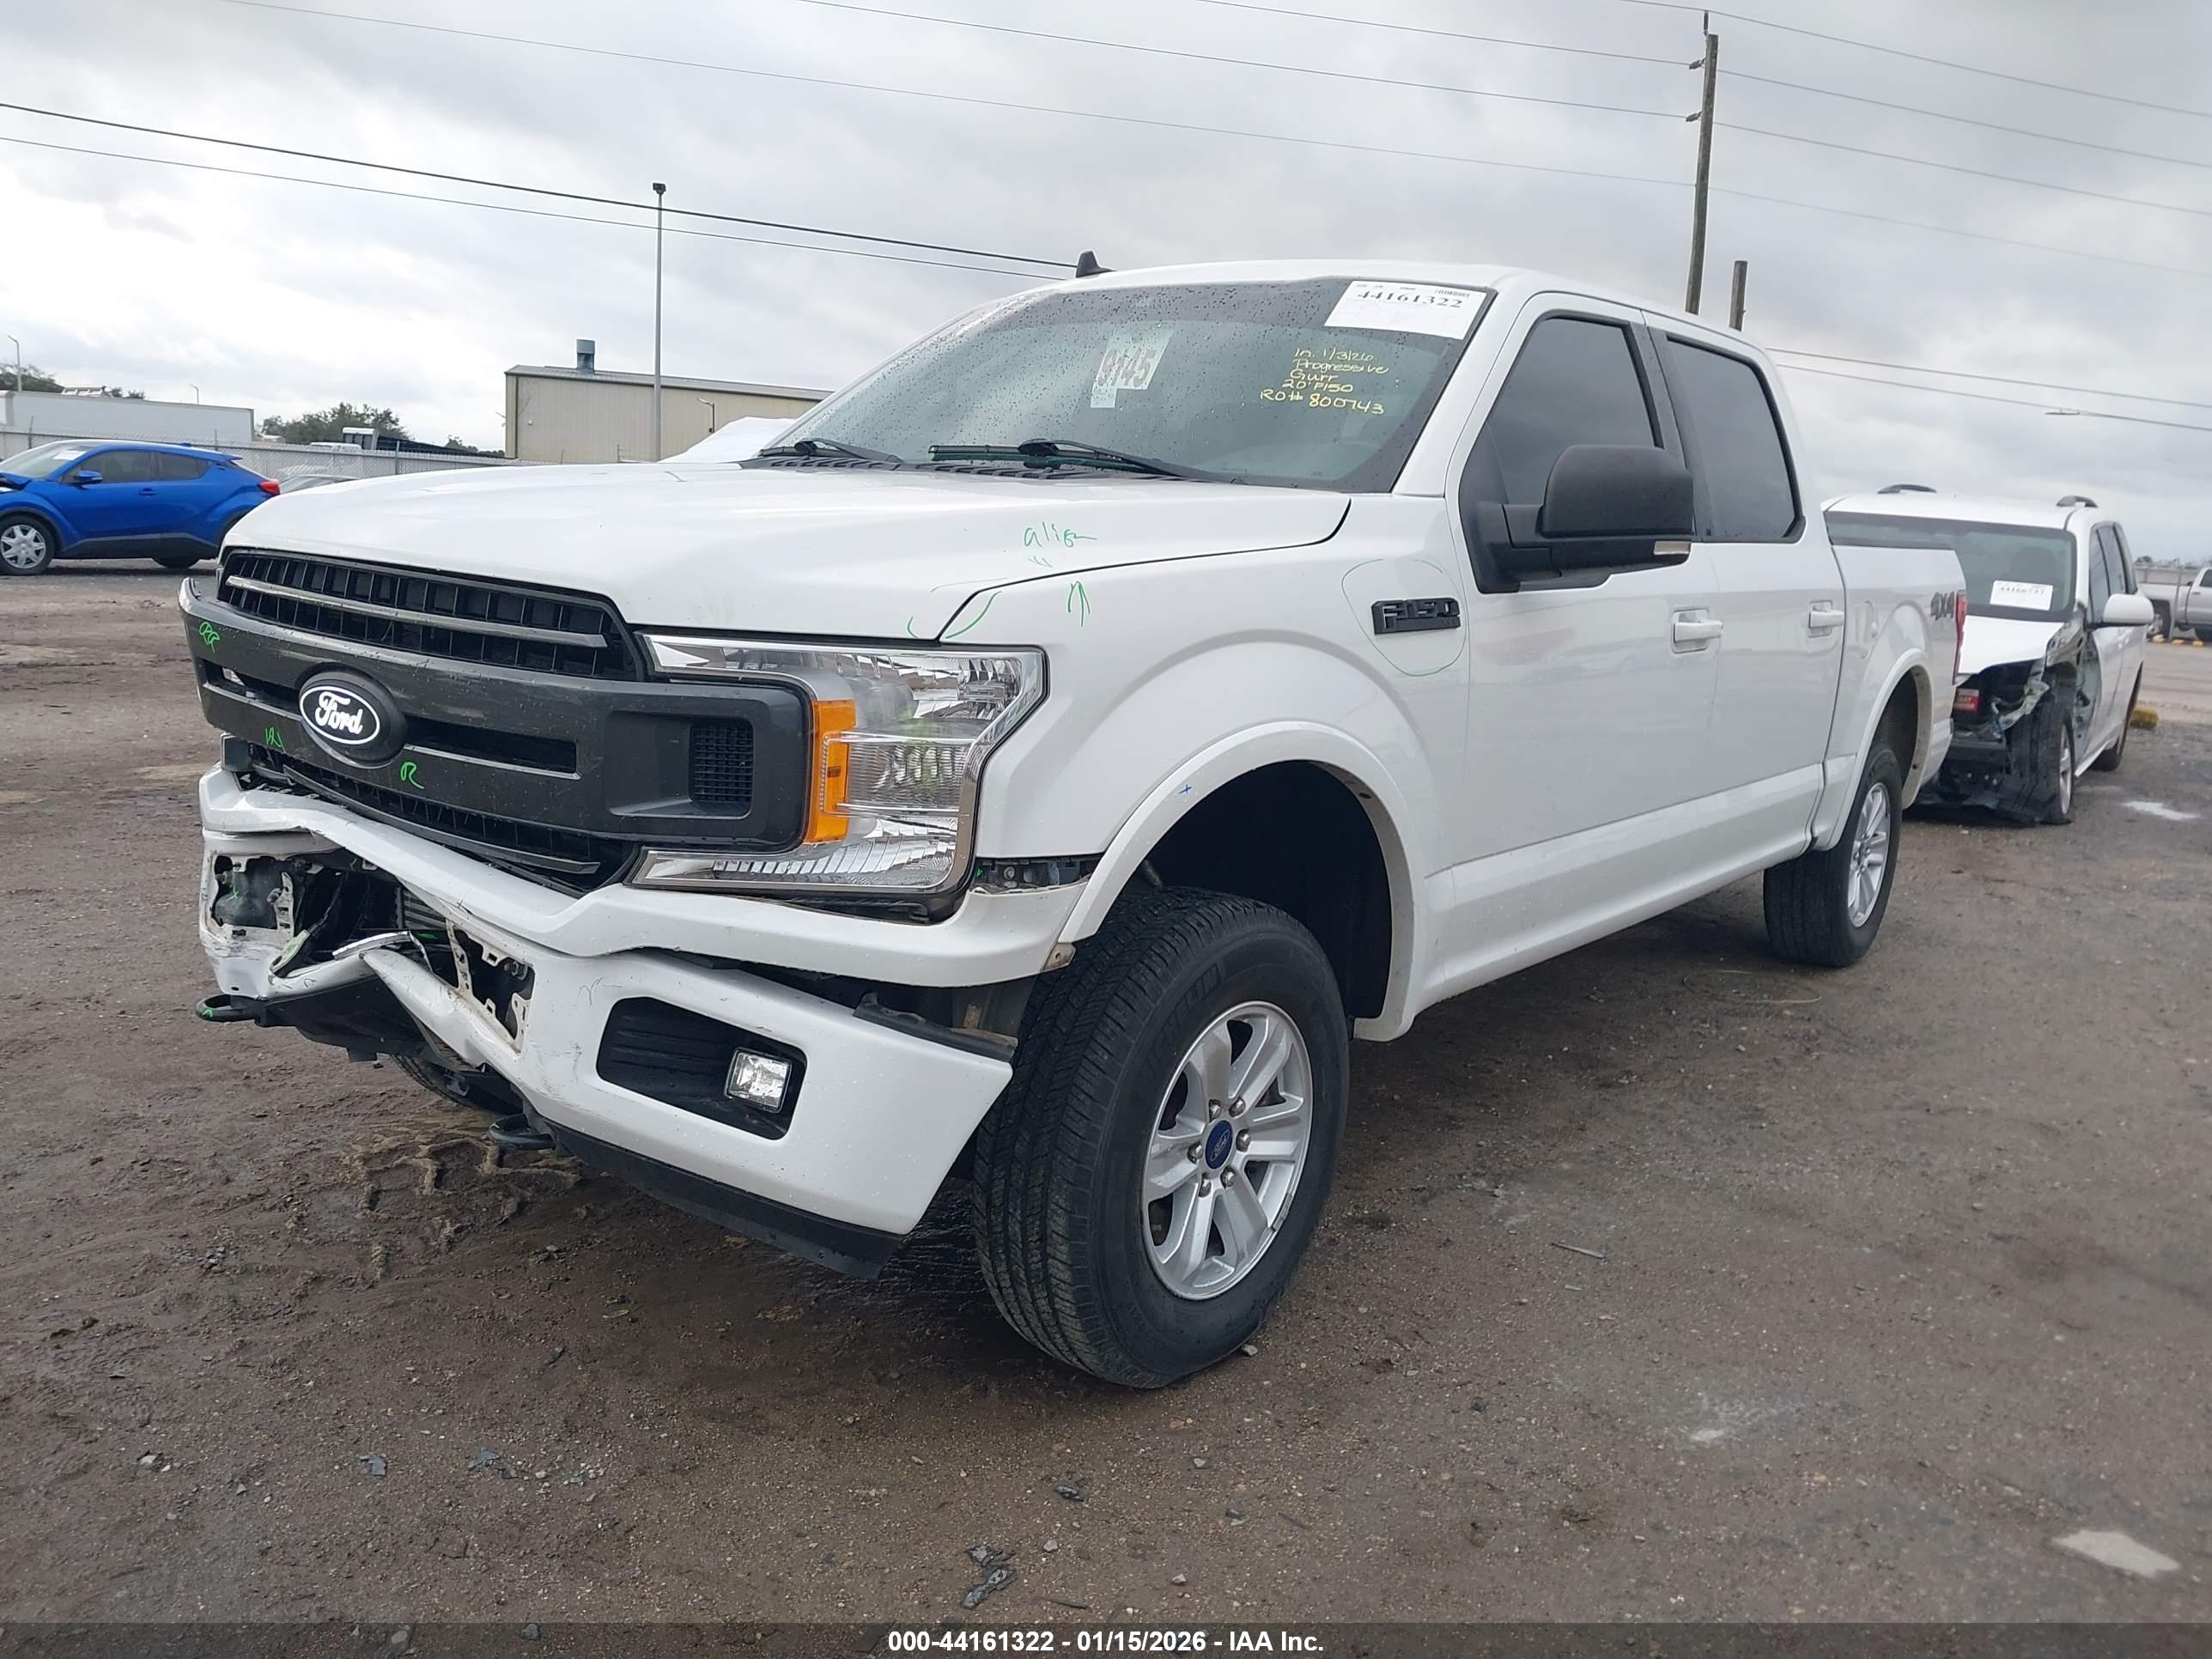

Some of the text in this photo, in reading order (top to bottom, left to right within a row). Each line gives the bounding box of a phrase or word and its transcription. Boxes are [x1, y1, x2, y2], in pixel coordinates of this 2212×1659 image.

[1357, 289, 1463, 309] 44161322
[1309, 393, 1384, 415] 800743
[314, 690, 364, 735] Ford
